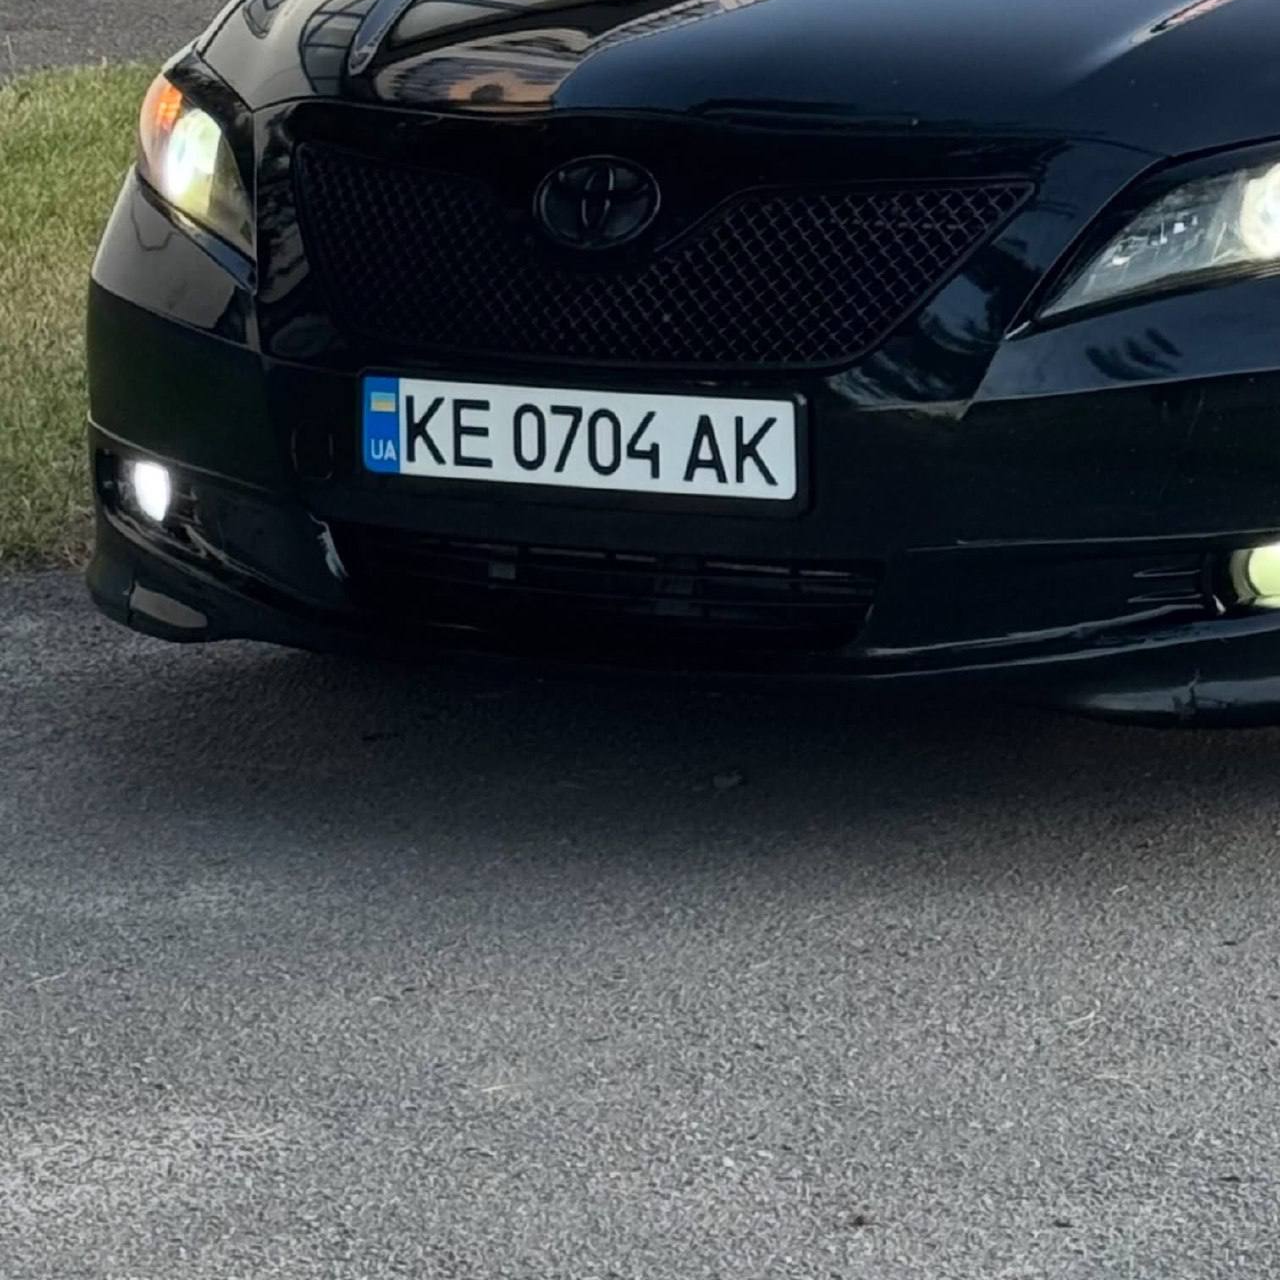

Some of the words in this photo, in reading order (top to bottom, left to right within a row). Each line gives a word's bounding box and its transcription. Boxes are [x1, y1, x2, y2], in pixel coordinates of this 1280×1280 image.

[370, 438, 397, 461] UA
[405, 394, 494, 469] KE
[512, 402, 660, 480] 0704
[683, 413, 779, 487] AK
